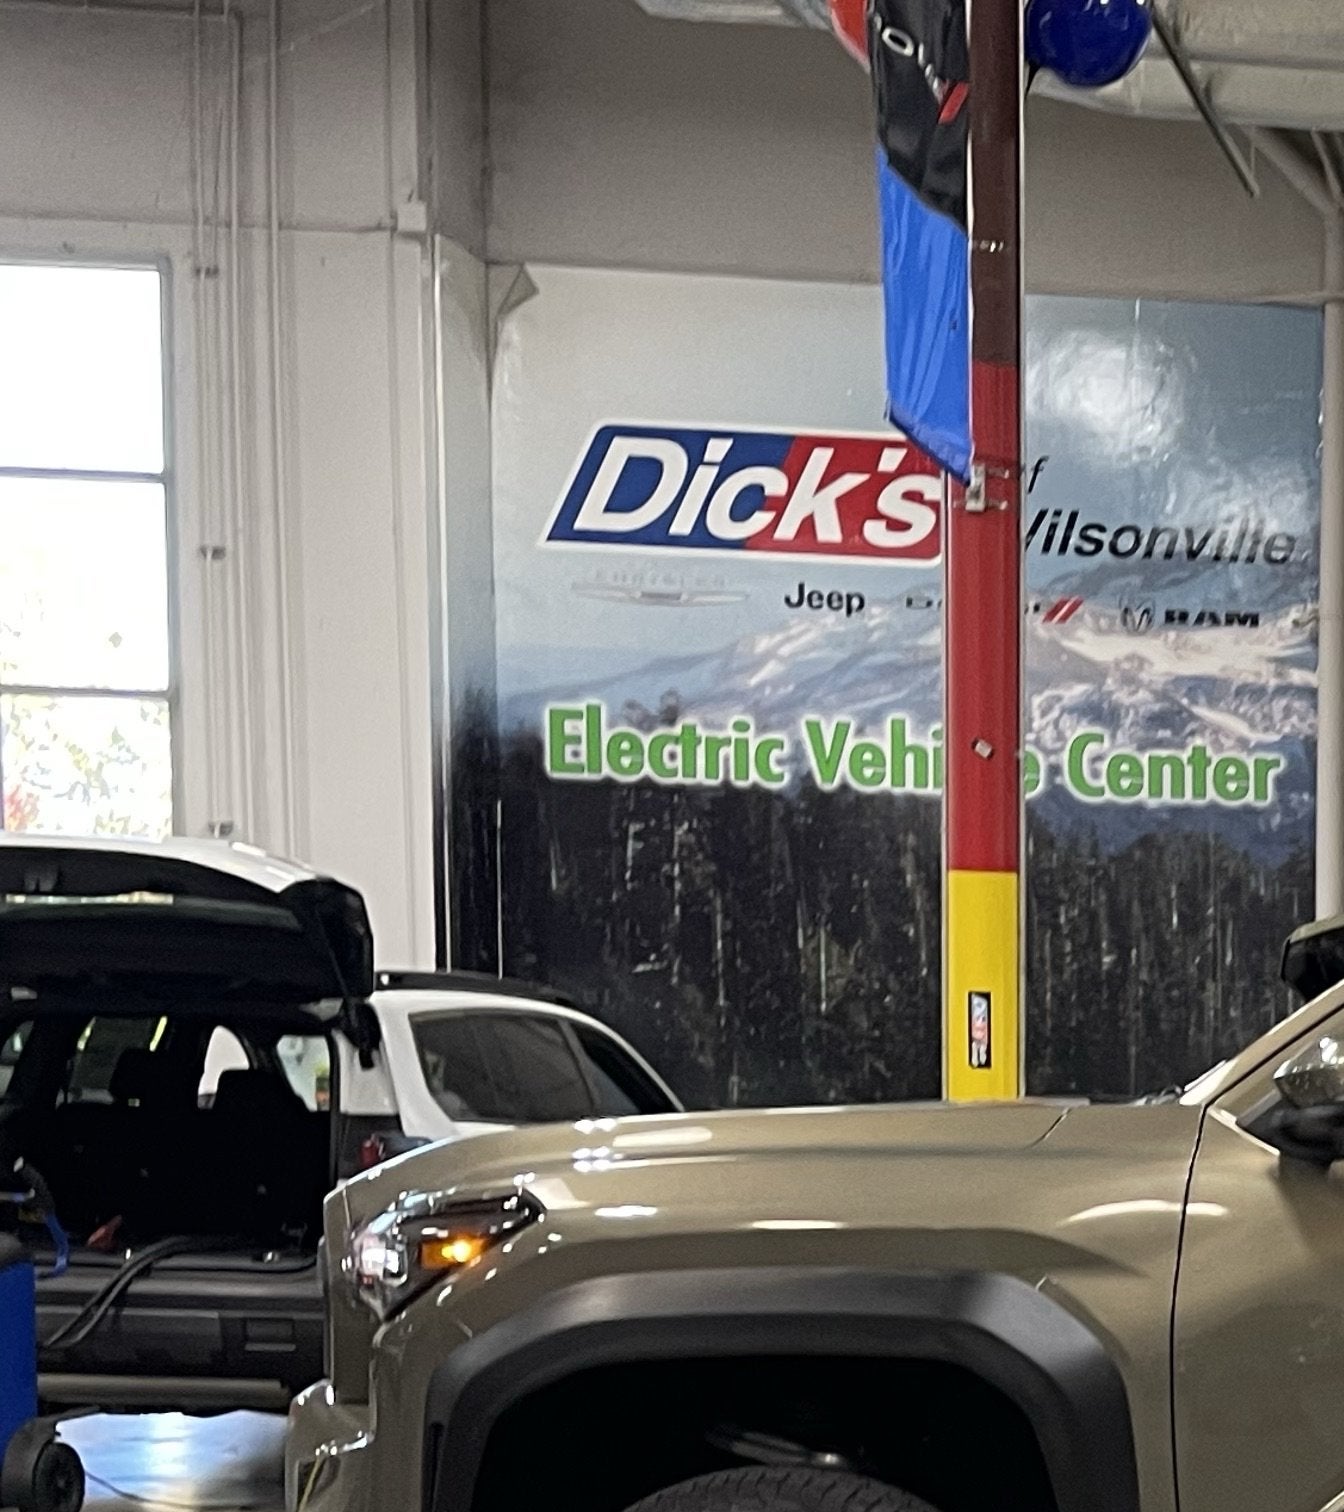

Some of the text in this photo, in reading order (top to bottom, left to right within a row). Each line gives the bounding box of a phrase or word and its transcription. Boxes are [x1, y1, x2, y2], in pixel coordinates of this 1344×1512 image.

[573, 435, 943, 548] Dick's
[1025, 455, 1049, 494] f
[784, 581, 866, 617] Jeep
[1163, 608, 1260, 628] RAM
[548, 703, 1281, 801] Electric Vehi Center
